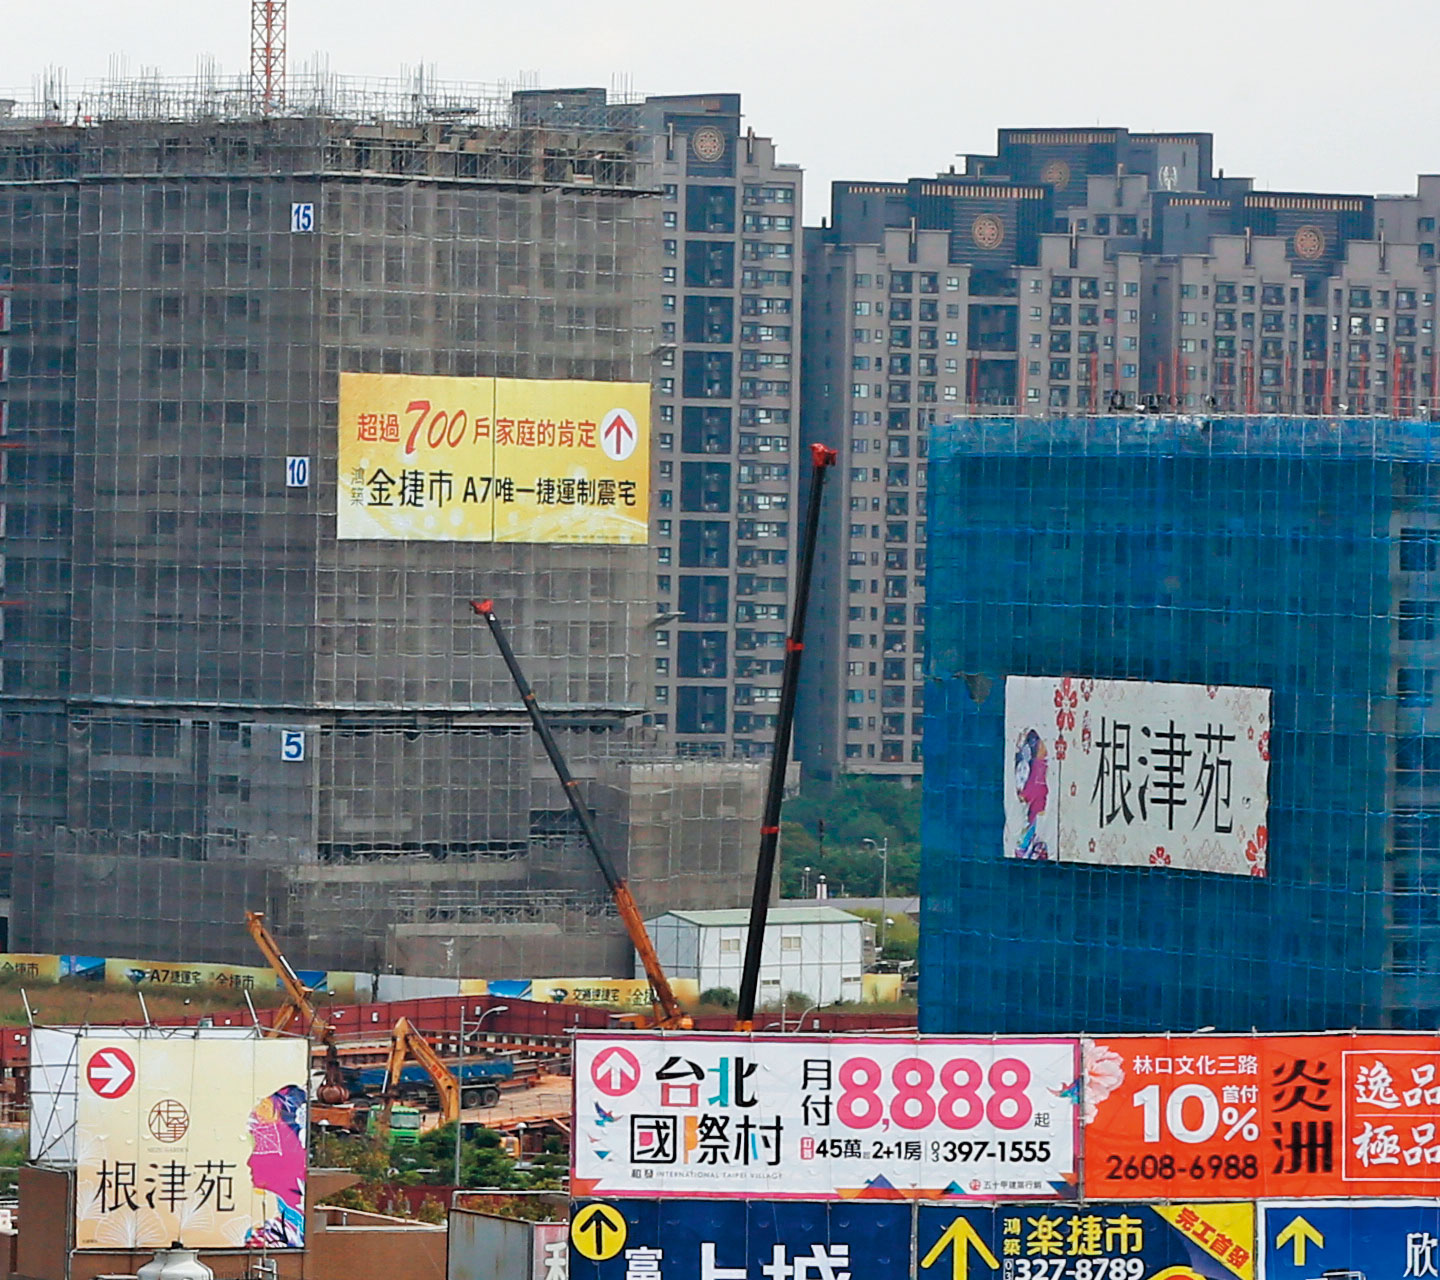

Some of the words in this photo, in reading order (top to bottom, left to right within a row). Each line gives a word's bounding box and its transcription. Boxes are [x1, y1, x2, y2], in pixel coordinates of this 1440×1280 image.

[293, 204, 313, 231] 15
[356, 400, 597, 455] 超過700戶家庭的肯定
[288, 458, 307, 486] 10
[366, 467, 453, 508] 金捷市
[462, 476, 637, 507] A7唯一捷運制震宅
[283, 732, 303, 759] 5
[1089, 715, 1237, 834] 根津苑
[654, 1055, 758, 1109] 台北
[1132, 1054, 1259, 1076] 林口文化三路
[801, 1058, 833, 1127] 月付
[835, 1056, 1033, 1132] 8,888
[1222, 1084, 1260, 1103] 首付
[1033, 1112, 1052, 1128] 起
[1270, 1057, 1334, 1175] 炎洲
[629, 1113, 784, 1167] 國際村
[872, 1138, 923, 1161] 2+1房
[942, 1140, 1052, 1164] 397-1555
[1105, 1154, 1260, 1181] 2608-6988
[92, 1159, 237, 1214] 根津苑
[1174, 1206, 1255, 1270] 完工首發
